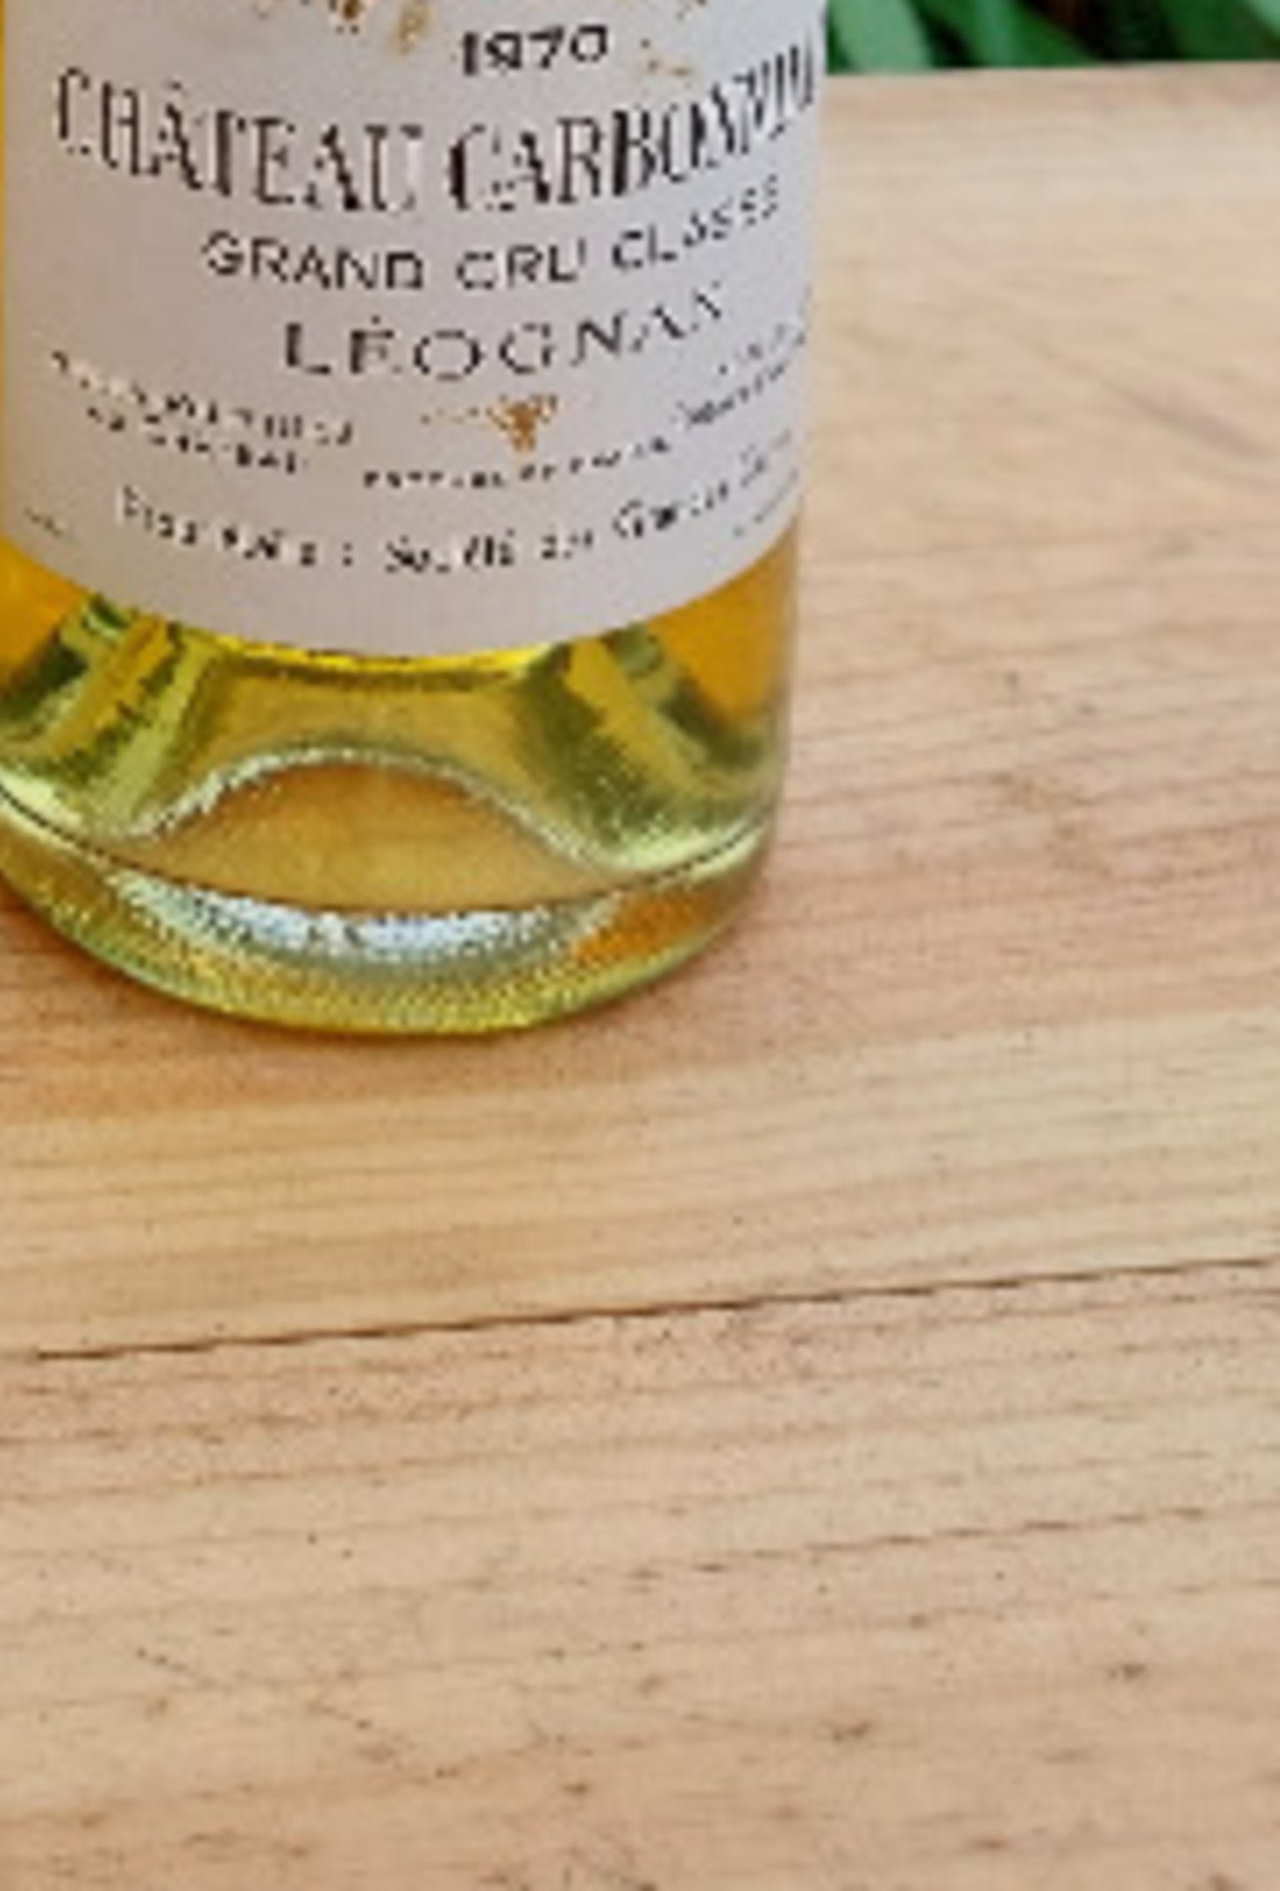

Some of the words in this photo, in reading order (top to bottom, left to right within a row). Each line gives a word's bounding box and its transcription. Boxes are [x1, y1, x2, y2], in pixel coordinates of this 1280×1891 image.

[463, 24, 608, 76] 1970
[57, 66, 423, 211] CHÂTEAU
[202, 230, 424, 290] GRAND
[456, 238, 586, 291] CRU
